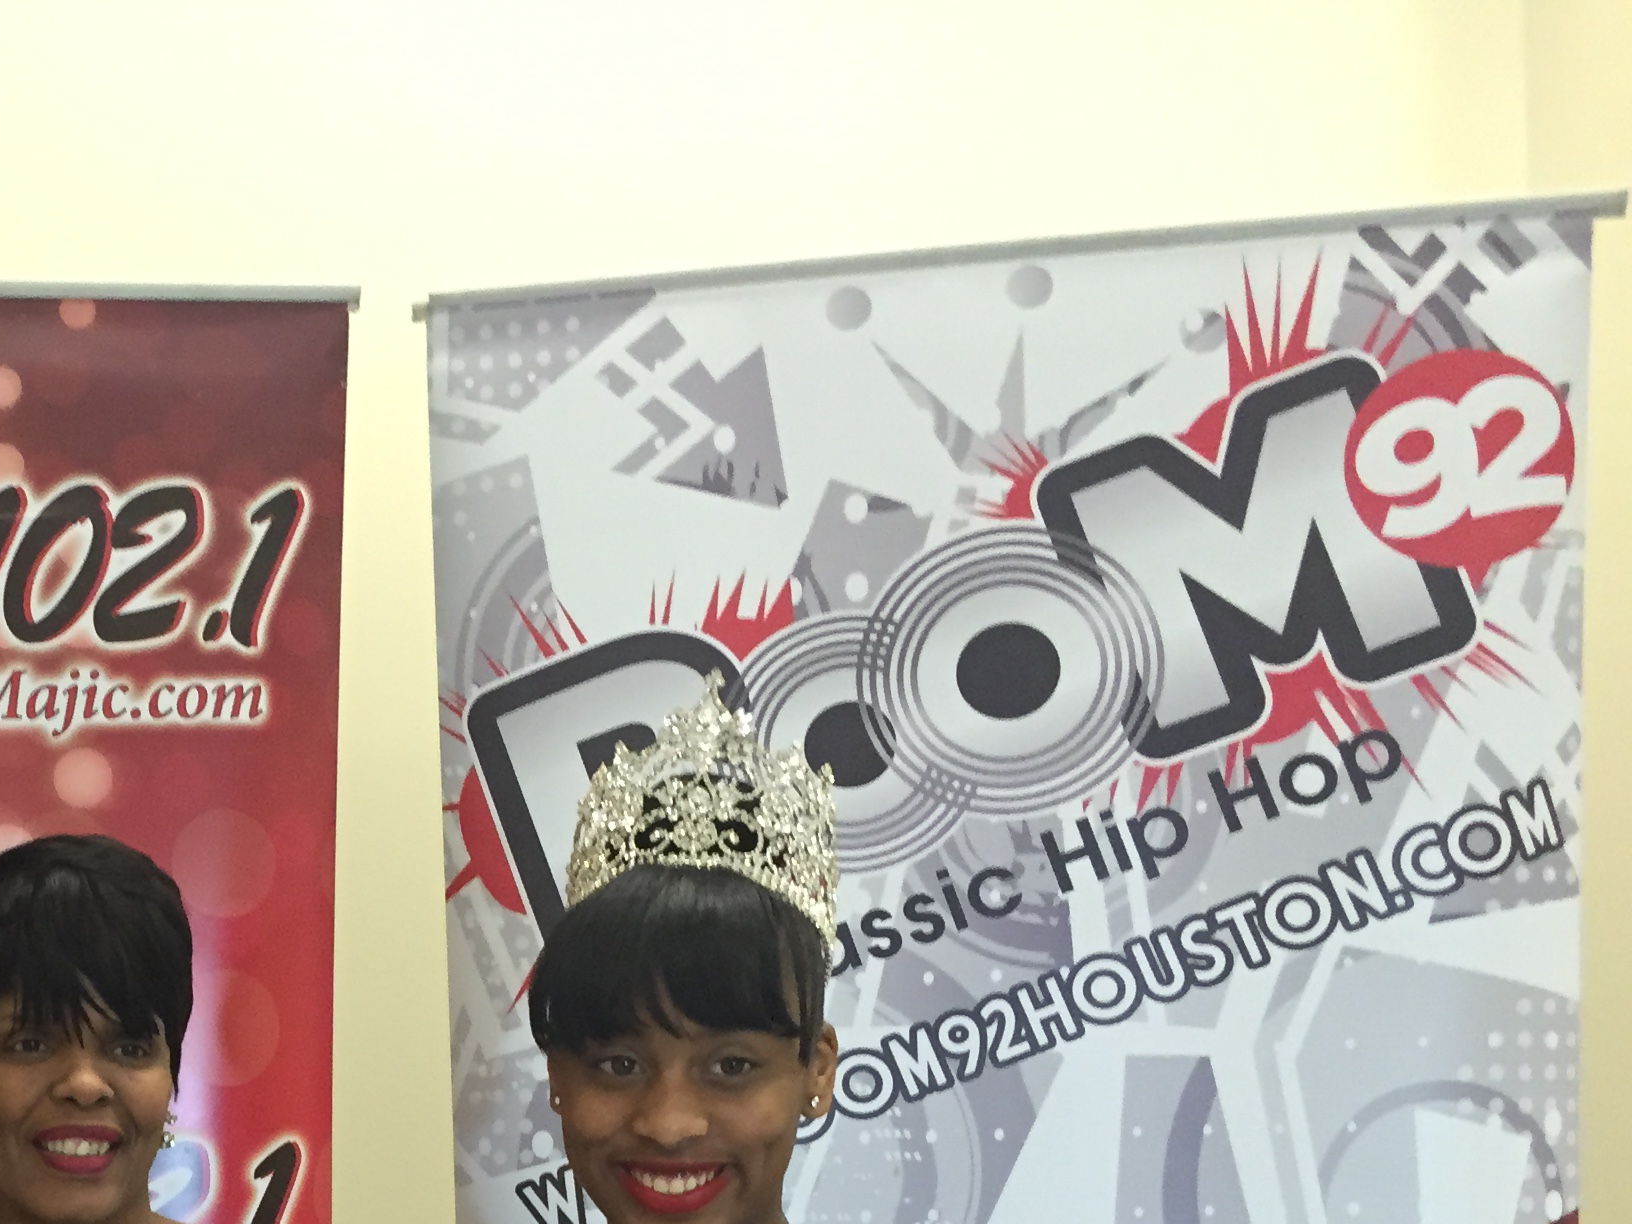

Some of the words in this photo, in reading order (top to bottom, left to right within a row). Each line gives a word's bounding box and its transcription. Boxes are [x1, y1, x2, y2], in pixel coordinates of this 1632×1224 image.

[1355, 374, 1565, 541] 92
[830, 867, 1024, 976] assic
[1040, 803, 1189, 893] Hip
[1207, 725, 1403, 835] Hop
